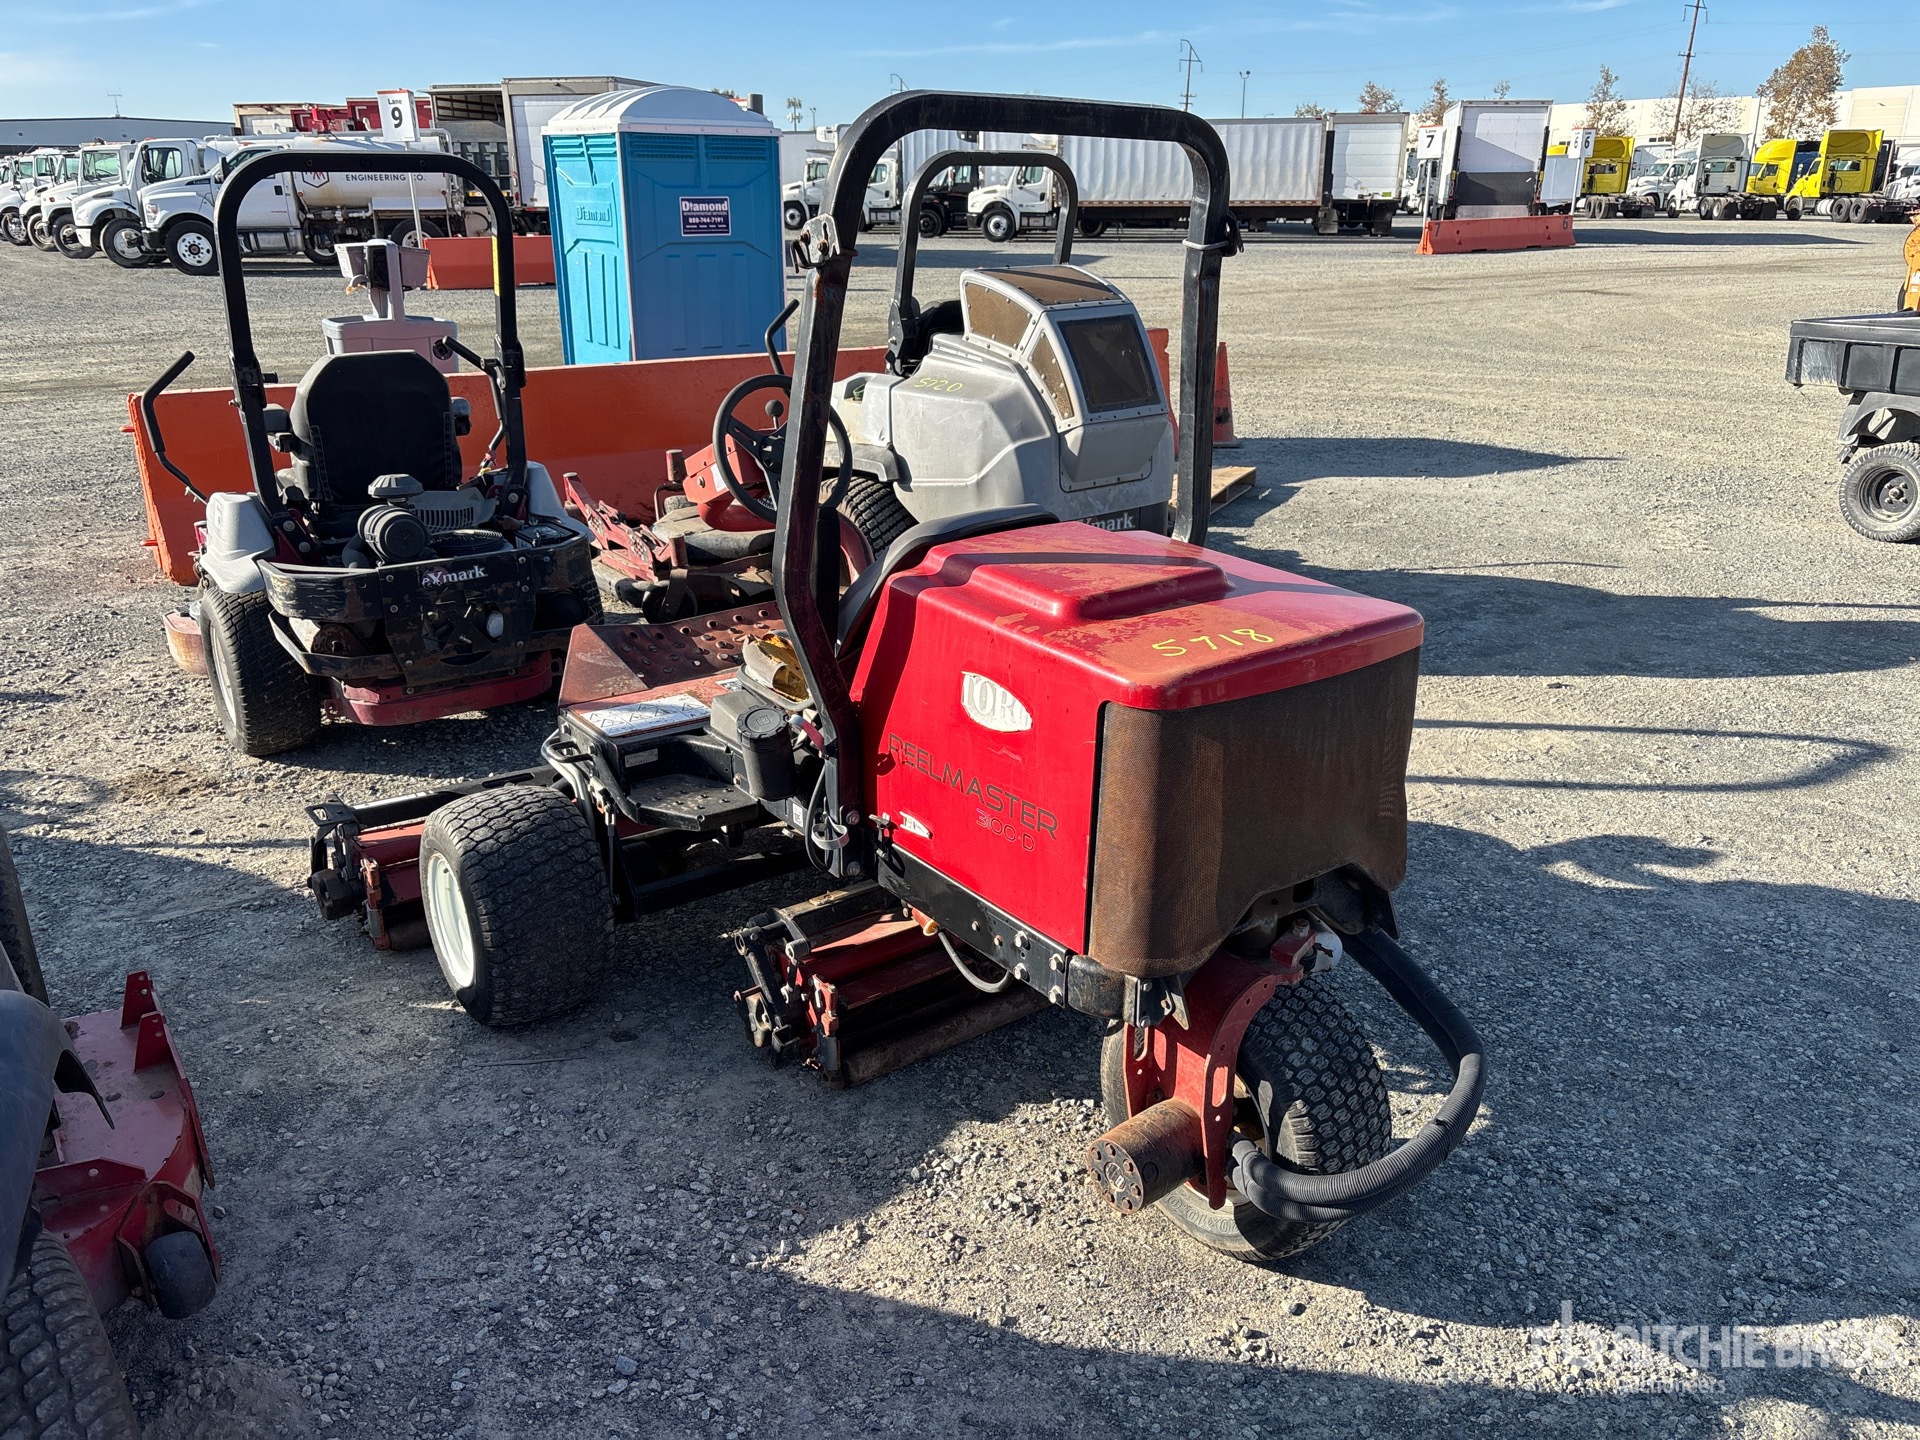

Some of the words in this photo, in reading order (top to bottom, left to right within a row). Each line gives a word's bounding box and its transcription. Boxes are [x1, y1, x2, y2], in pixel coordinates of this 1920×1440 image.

[391, 106, 403, 129] 9
[1426, 134, 1435, 149] 7
[1573, 136, 1579, 149] 6
[1584, 135, 1591, 149] 6
[682, 201, 728, 212] Diamond
[1433, 222, 1441, 238] 7
[1562, 217, 1569, 231] 6
[1152, 628, 1274, 657] 5718
